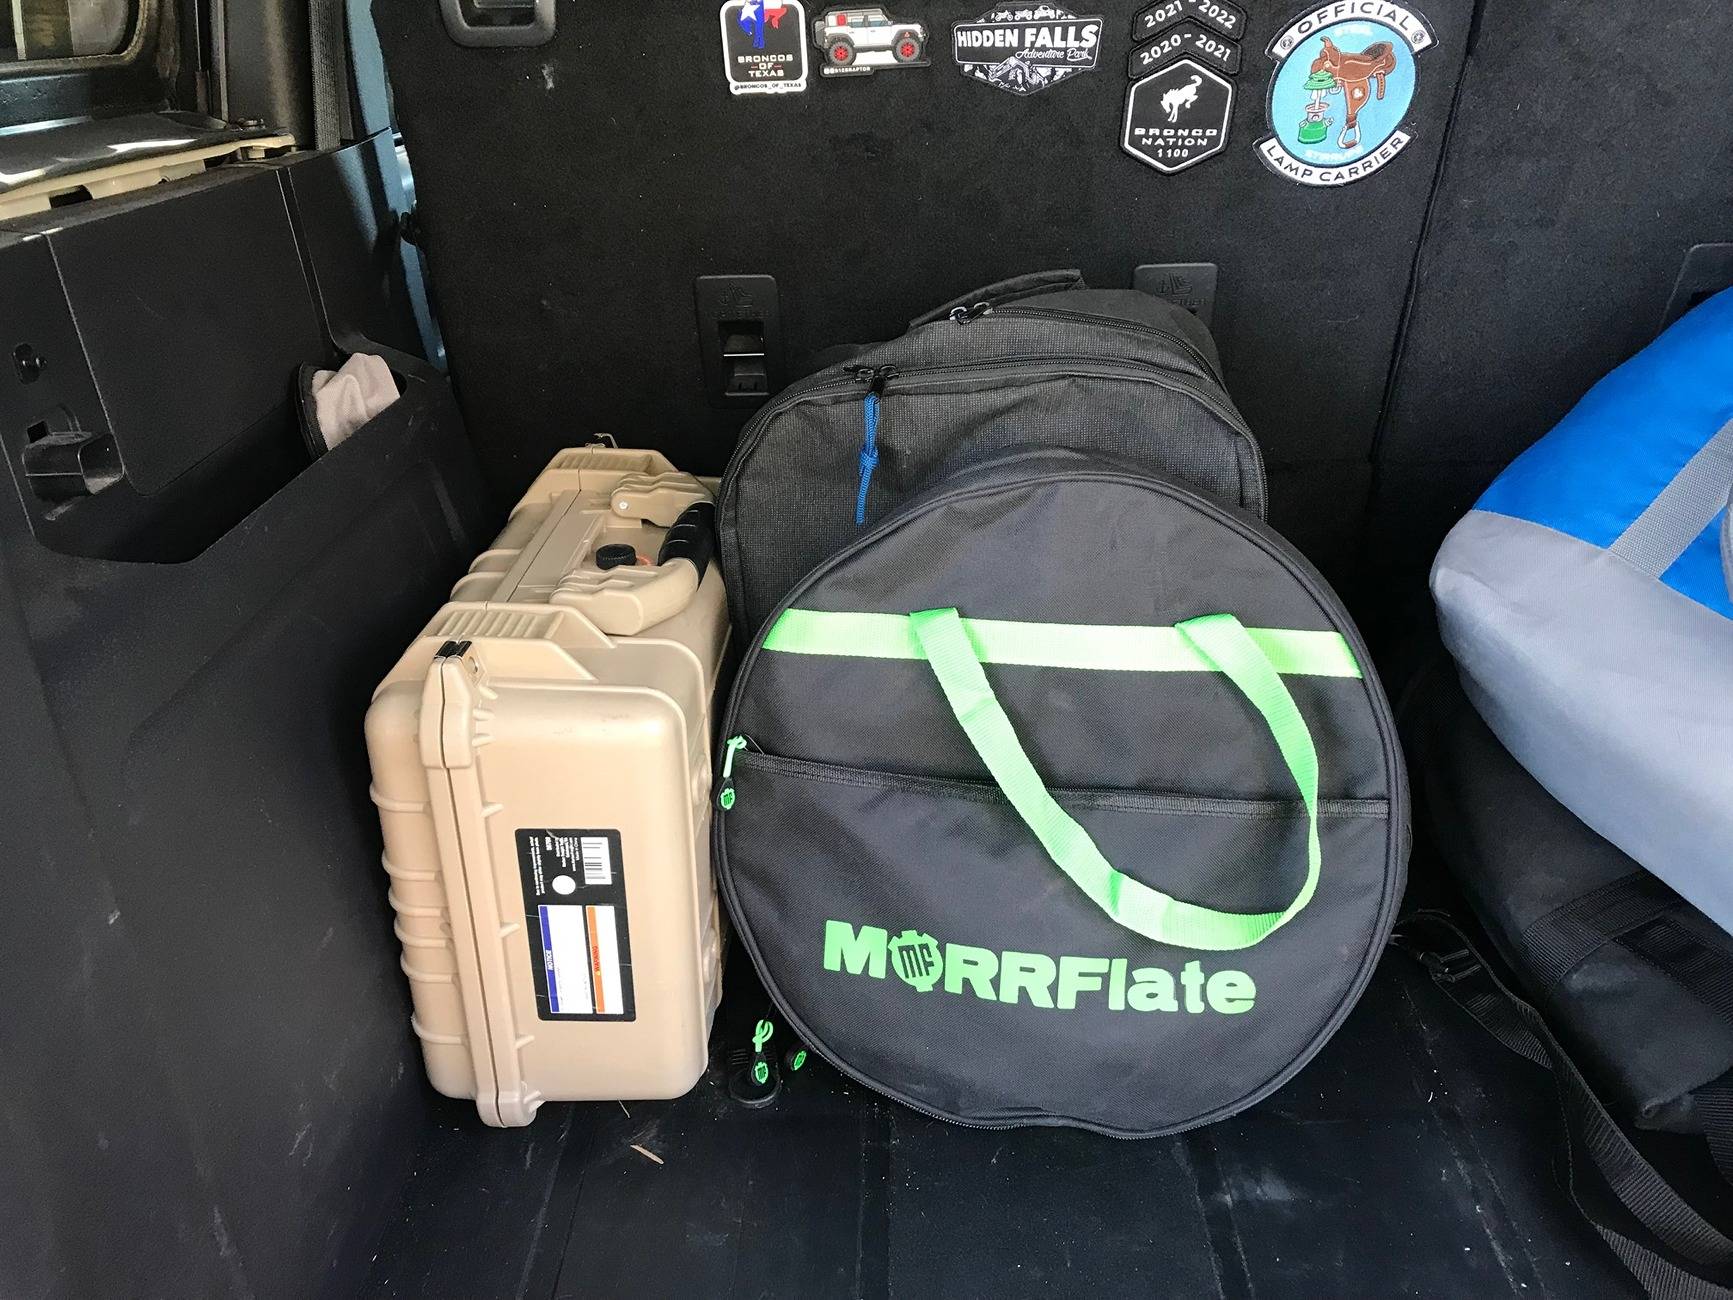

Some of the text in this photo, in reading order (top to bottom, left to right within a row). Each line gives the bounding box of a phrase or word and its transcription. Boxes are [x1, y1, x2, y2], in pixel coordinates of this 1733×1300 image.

[1144, 0, 1183, 28] 2021
[1198, 0, 1236, 30] 2022
[1297, 2, 1411, 35] OFFICIAL
[957, 24, 1099, 48] HIDDEN FALLS
[1014, 47, 1093, 62] Adventure Park
[1140, 34, 1182, 65] 2020
[1195, 34, 1231, 62] 2021
[737, 54, 794, 63] BRONCOS
[758, 62, 774, 70] OF
[748, 69, 785, 78] TEXAS
[1134, 127, 1218, 136] BRONCO
[1141, 137, 1208, 146] NATION
[1157, 148, 1189, 158] 1100
[1266, 136, 1405, 183] LAMP CARRIER
